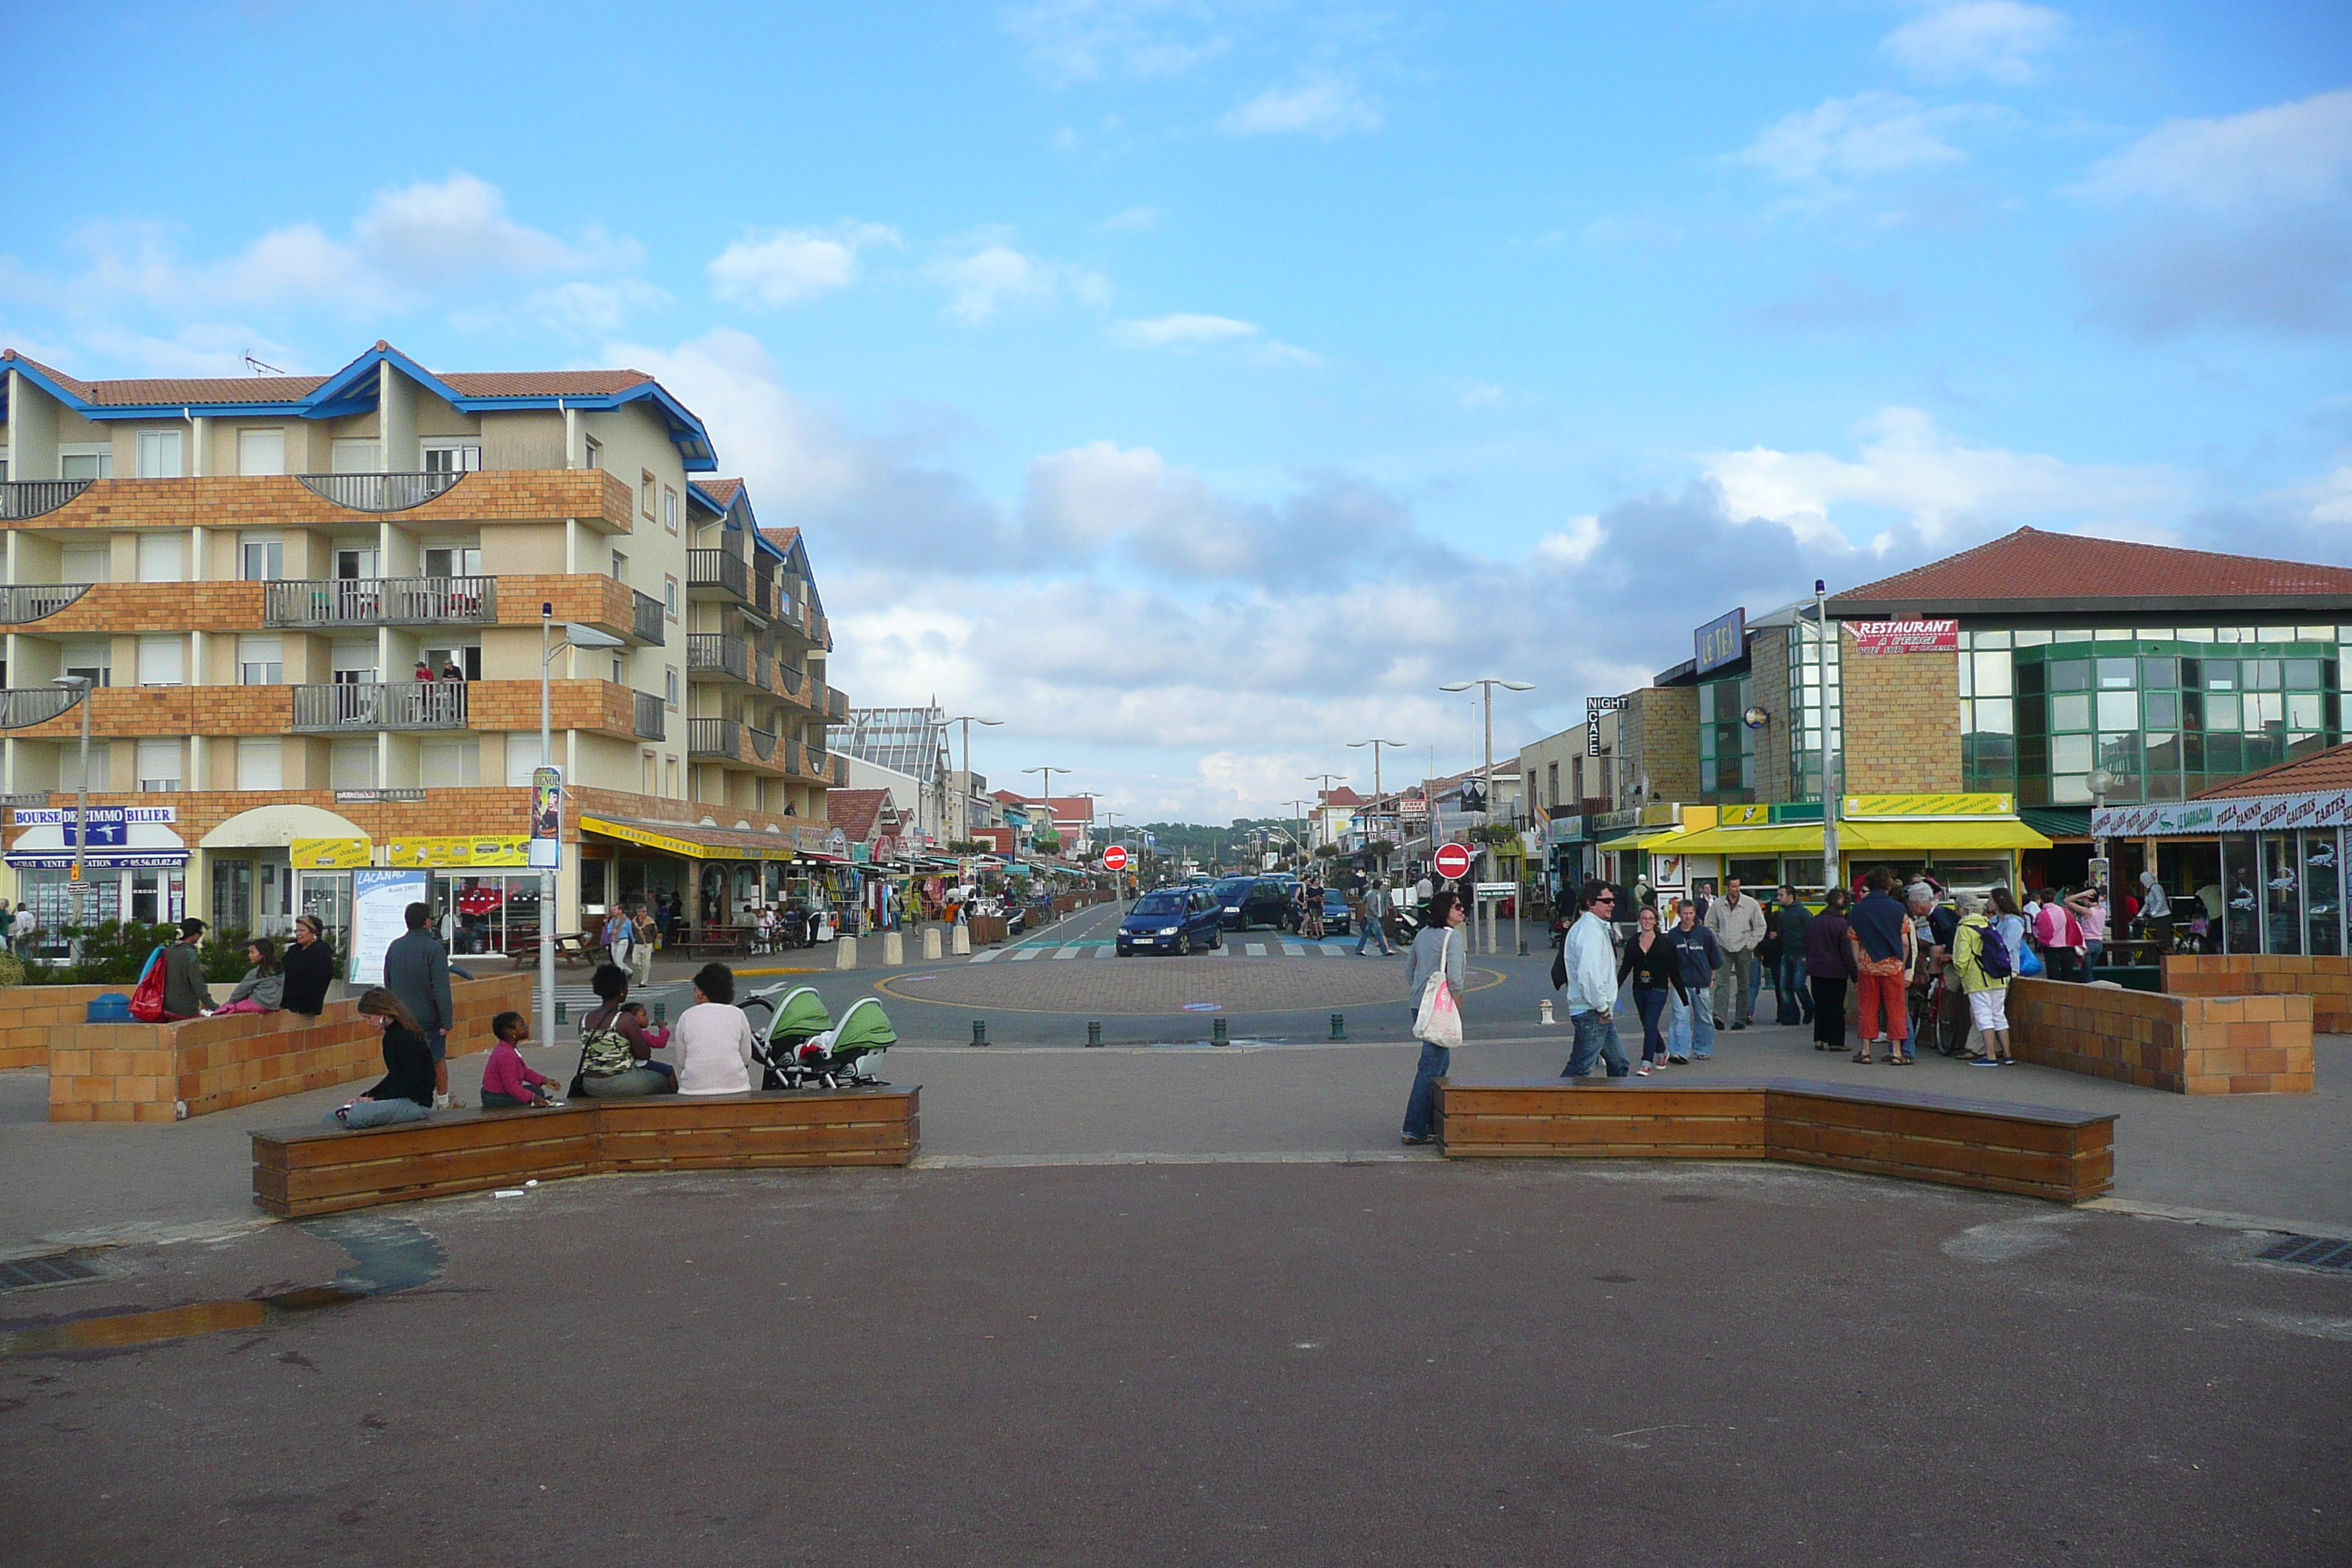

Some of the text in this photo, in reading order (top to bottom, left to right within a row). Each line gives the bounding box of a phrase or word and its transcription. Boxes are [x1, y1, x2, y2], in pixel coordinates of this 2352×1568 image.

[1860, 621, 1954, 634] RESTAURANT
[1702, 633, 1714, 666] LE
[1858, 647, 1880, 655] VUE
[1878, 637, 1888, 646] A
[1588, 698, 1628, 709] NIGHT
[1588, 712, 1599, 756] CAFE
[16, 810, 61, 823] BOURSE
[127, 809, 170, 821] BILIER
[2217, 804, 2237, 828] PIZZA
[2236, 802, 2261, 828] PANINIS
[2260, 800, 2287, 827] CRÊPES
[2286, 798, 2315, 826] GAUFRES
[2315, 792, 2345, 825] TARTES
